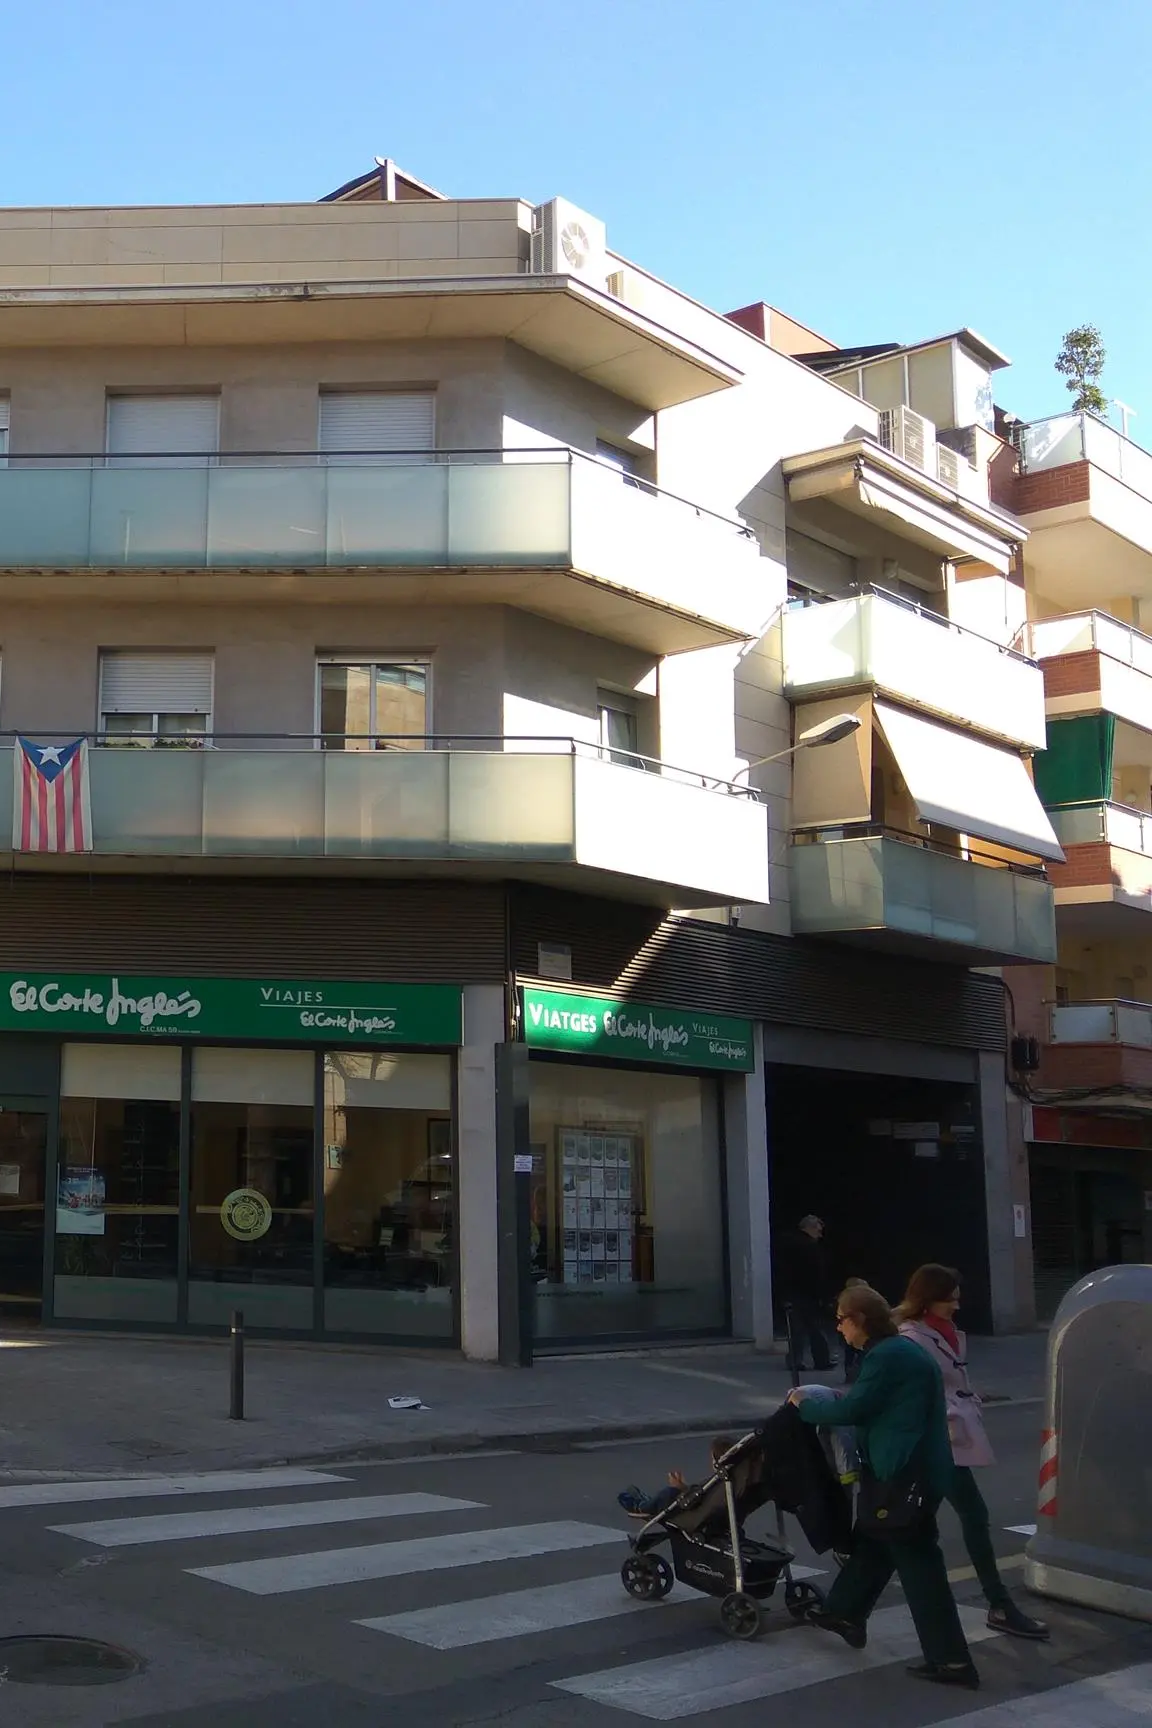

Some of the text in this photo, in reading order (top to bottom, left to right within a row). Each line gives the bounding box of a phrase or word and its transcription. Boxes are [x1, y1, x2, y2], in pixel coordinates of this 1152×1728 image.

[10, 980, 40, 1012] El
[39, 983, 104, 1013] Corte
[105, 978, 201, 1026] Inglés
[260, 987, 323, 1004] VIAJES
[300, 1010, 396, 1033] El Corte Inglés
[528, 1002, 688, 1050] VIATGES El Corte Inglés
[692, 1022, 719, 1037] VIAJES
